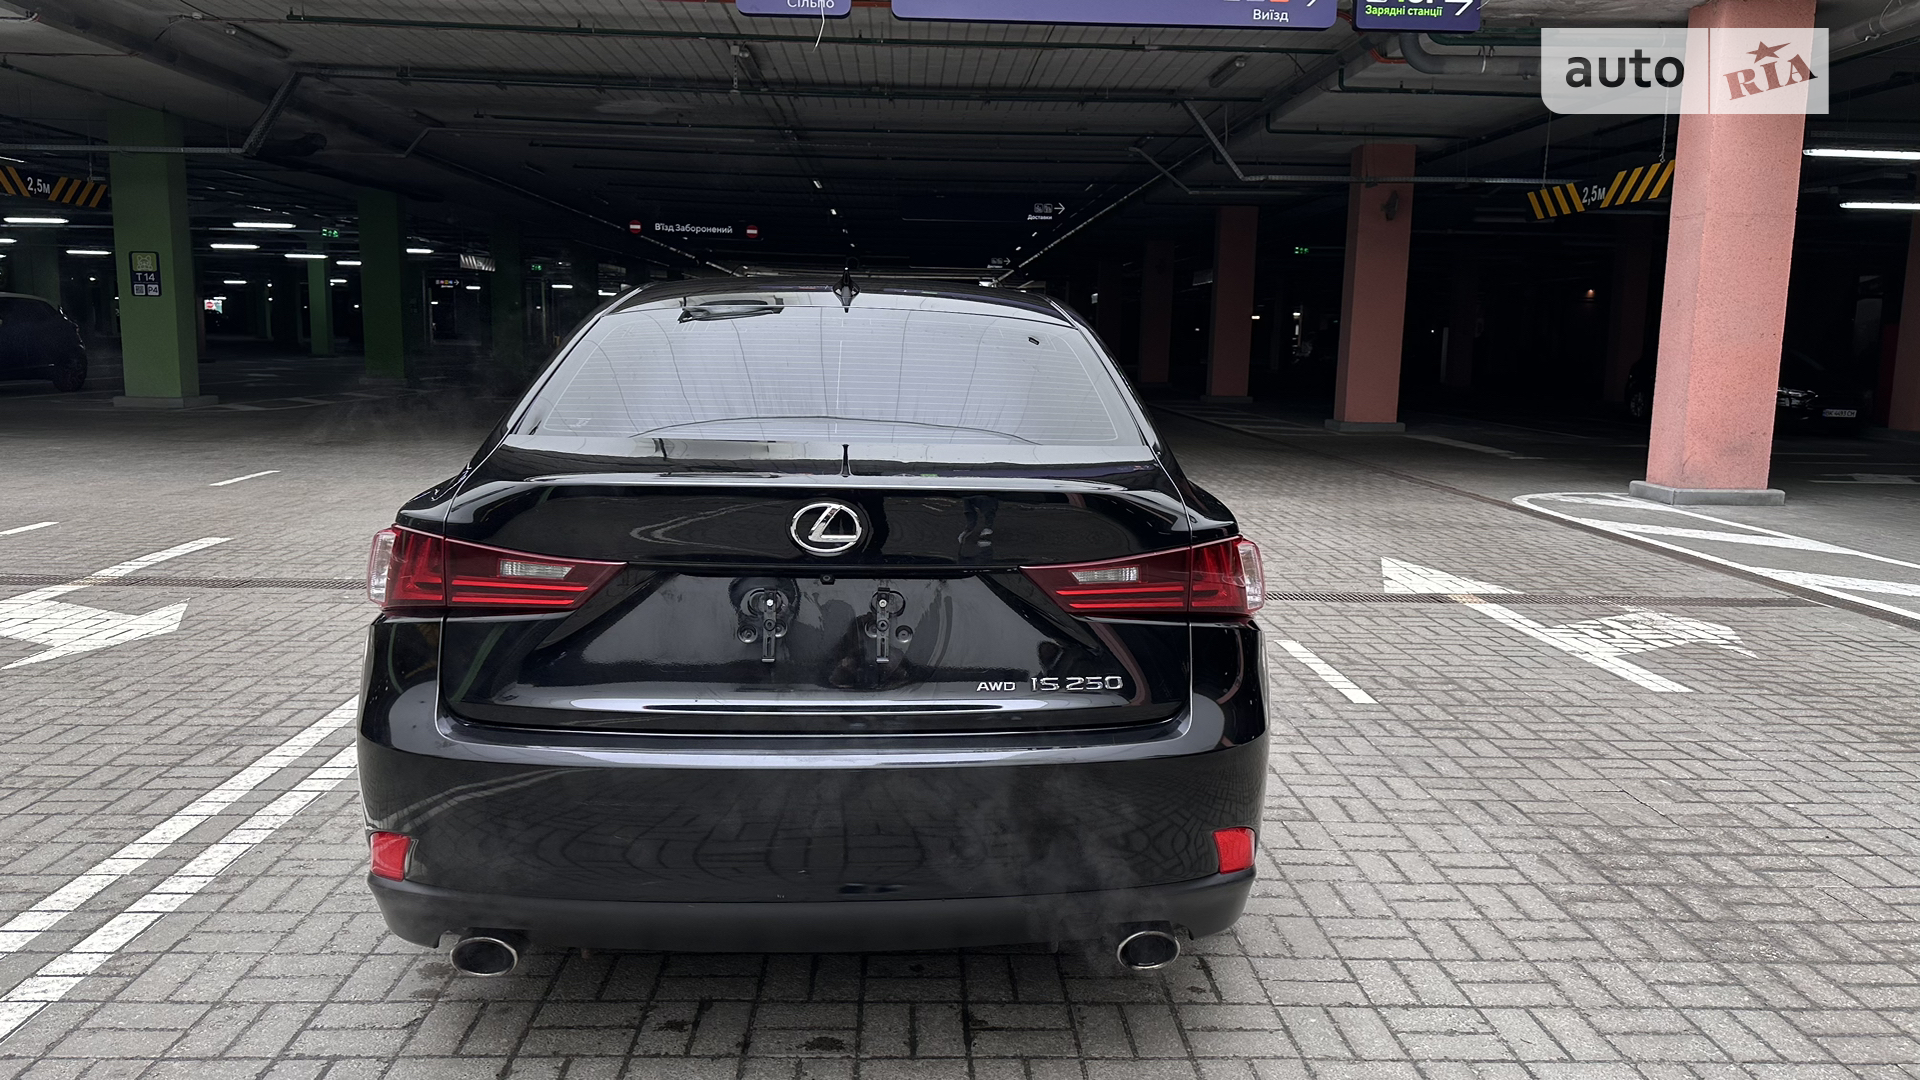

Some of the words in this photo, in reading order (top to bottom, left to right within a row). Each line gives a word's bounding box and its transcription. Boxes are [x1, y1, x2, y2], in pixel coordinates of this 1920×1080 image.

[1253, 8, 1289, 23] Виїзд
[1365, 5, 1406, 17] Зарядні
[1407, 6, 1443, 17] станції
[675, 223, 733, 234] Заборонений
[976, 681, 1017, 692] AWD
[1030, 677, 1060, 692] IS
[1065, 676, 1124, 691] 250
